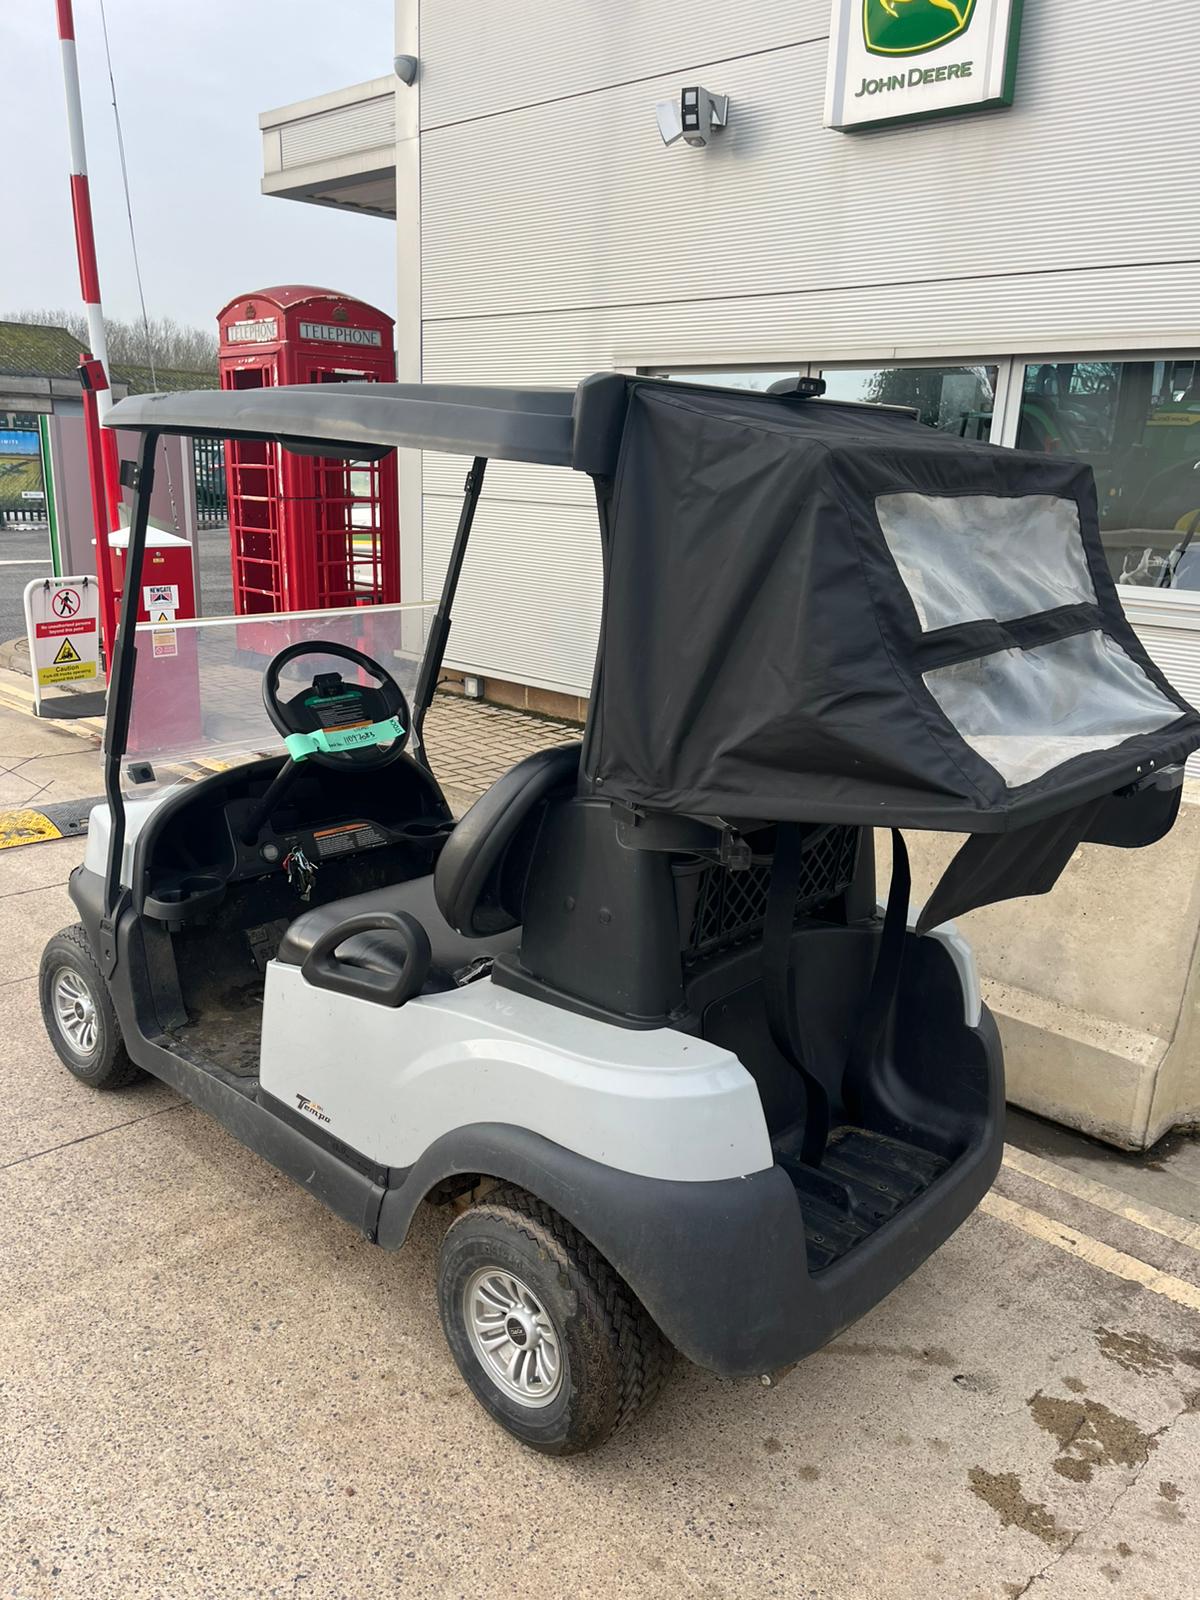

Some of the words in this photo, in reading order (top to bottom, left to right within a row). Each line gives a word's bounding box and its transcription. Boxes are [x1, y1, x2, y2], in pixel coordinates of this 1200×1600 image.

[855, 73, 905, 97] JOHN
[908, 61, 973, 87] DEERE
[230, 323, 276, 342] TELEPHONE
[303, 324, 379, 345] TELEPHONE
[295, 1092, 331, 1124] Tempo
